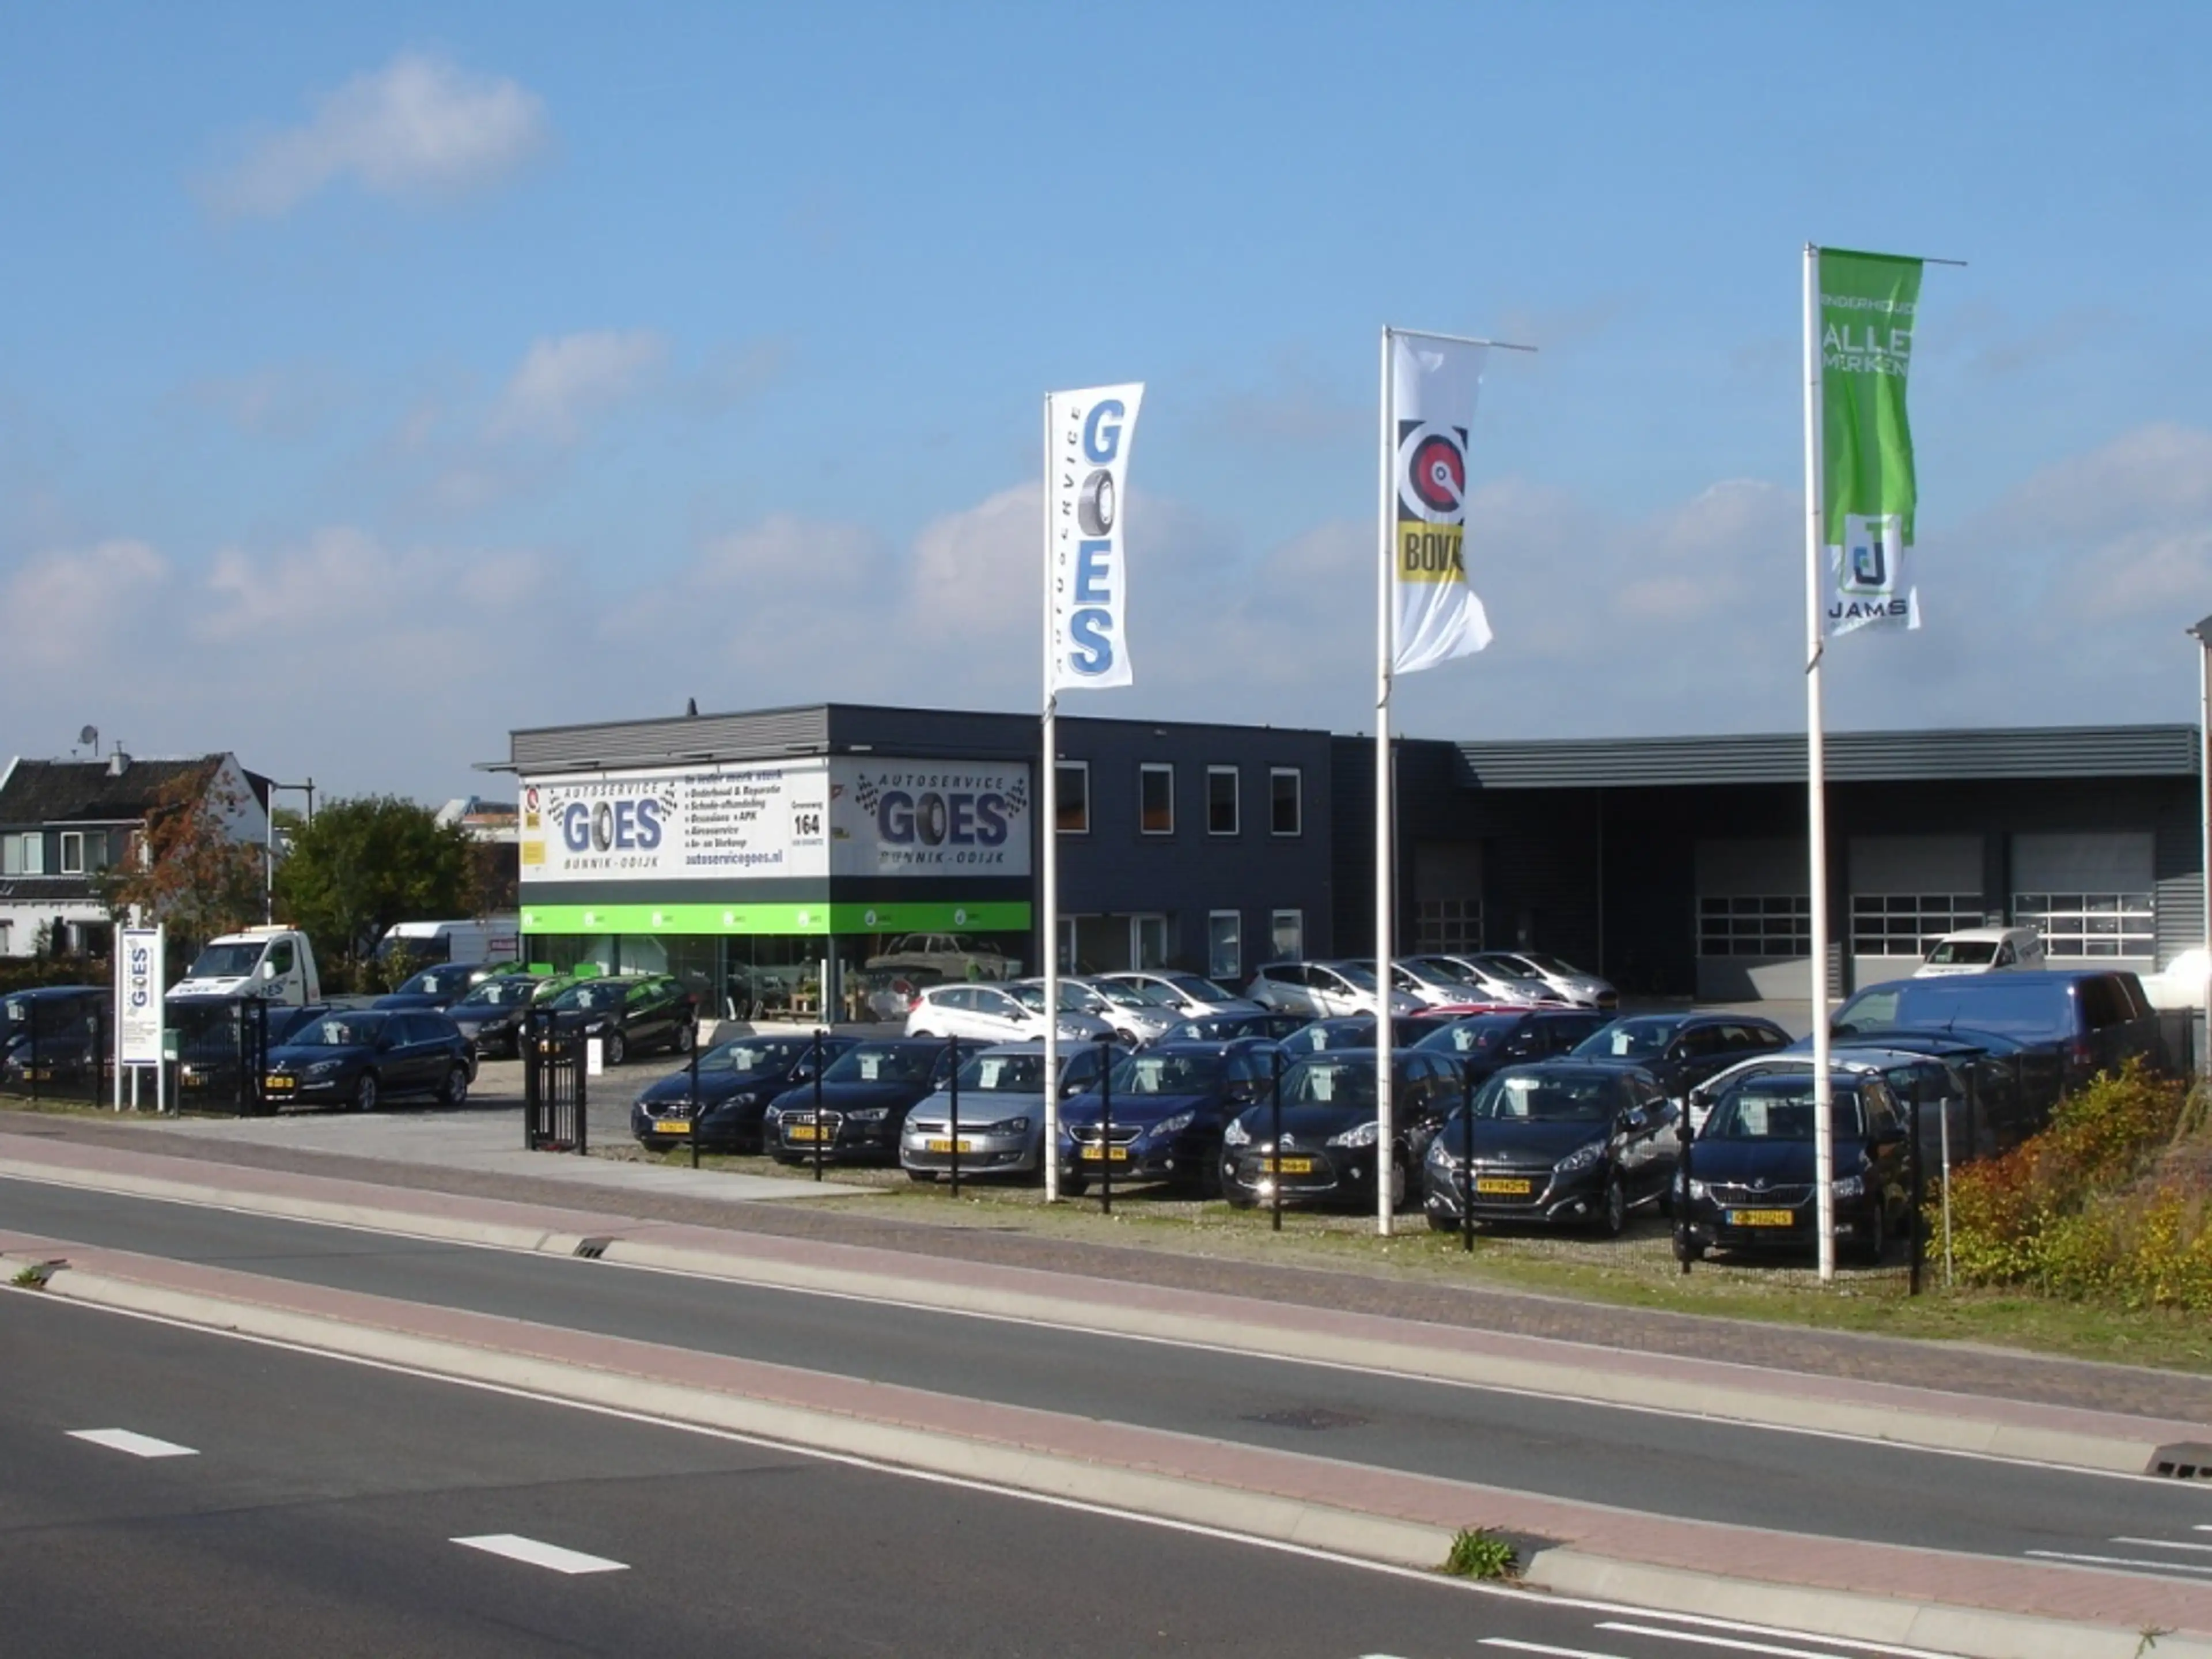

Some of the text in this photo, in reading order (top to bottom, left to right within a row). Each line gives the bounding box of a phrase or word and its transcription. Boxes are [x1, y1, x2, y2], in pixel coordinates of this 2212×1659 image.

[1823, 323, 1914, 358] ALLE
[1823, 351, 1910, 377] MERKEN
[1069, 399, 1125, 676] GOES
[1828, 600, 1908, 618] JAMS
[564, 782, 658, 798] AUTOSERVICE
[878, 773, 1004, 789] AUTOSERVICE
[564, 798, 662, 853] GOES
[795, 814, 820, 835] 164
[877, 790, 1007, 847] GOES
[131, 948, 147, 1007] GOES
